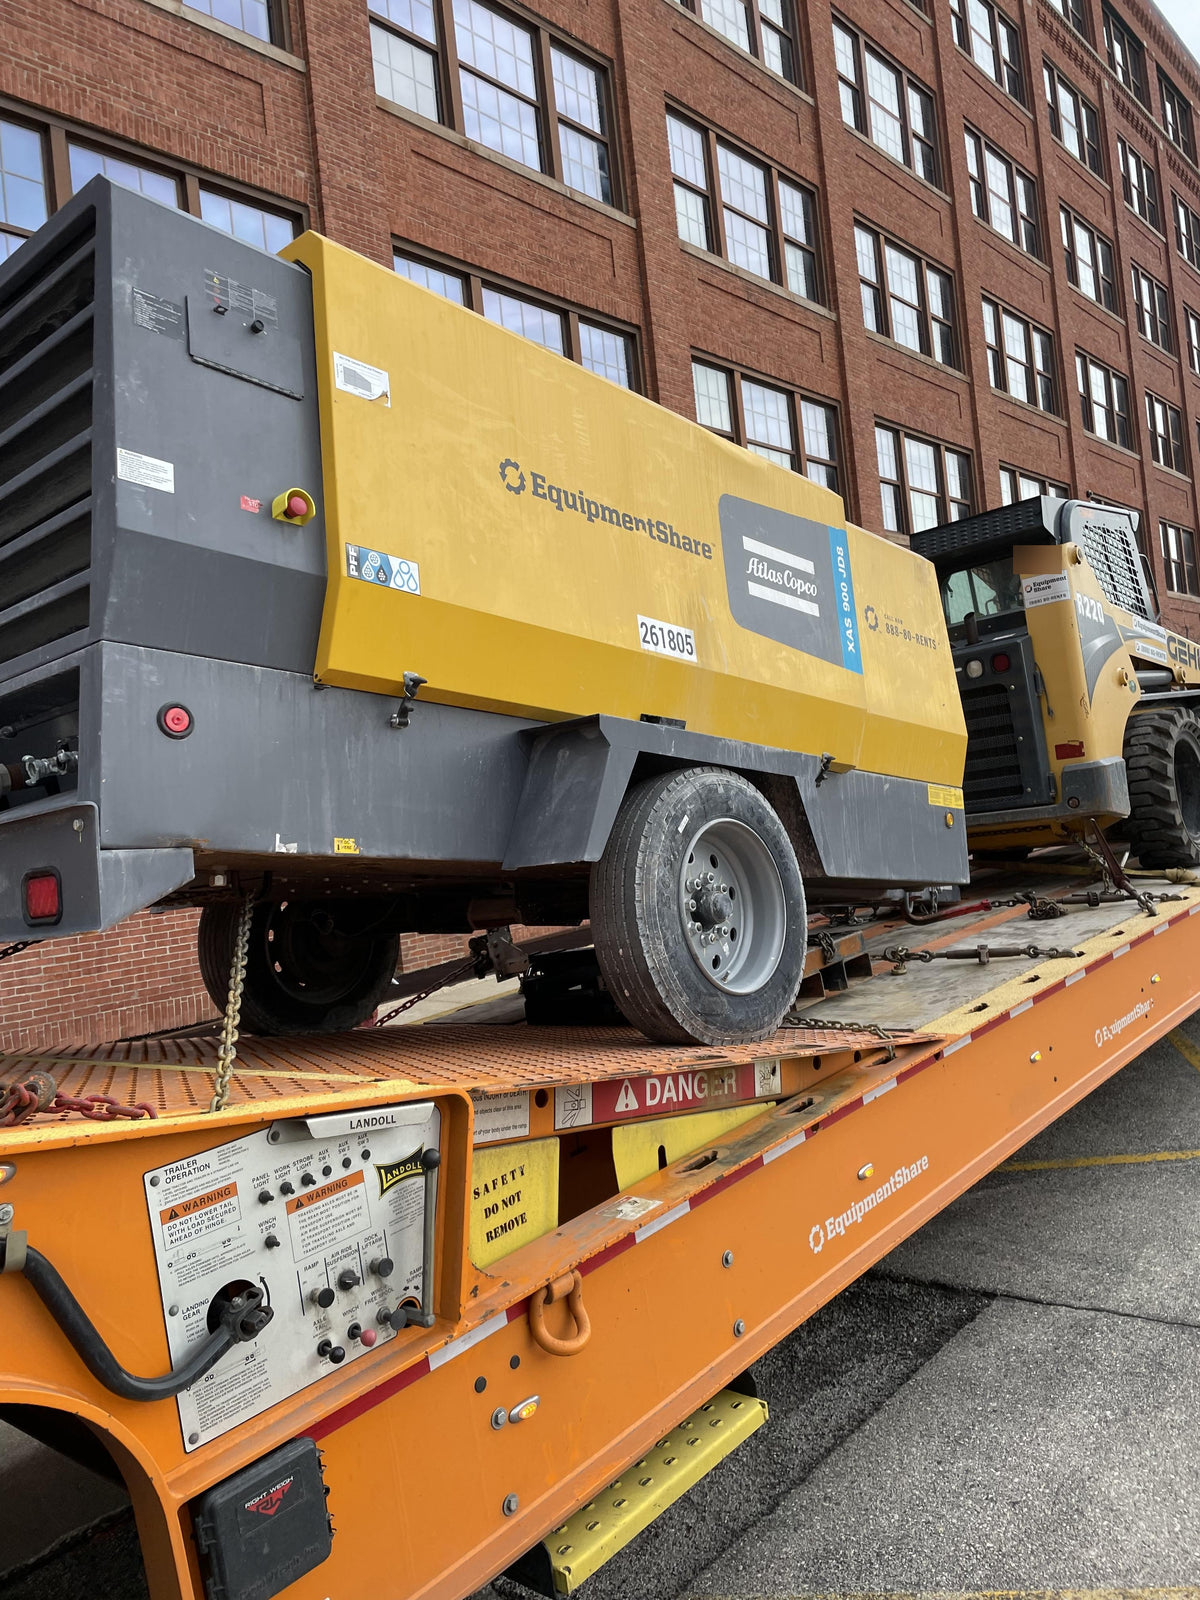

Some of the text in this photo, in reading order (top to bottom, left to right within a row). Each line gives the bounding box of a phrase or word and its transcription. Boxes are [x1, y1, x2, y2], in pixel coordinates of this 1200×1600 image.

[530, 471, 713, 560] EquipmentShare
[348, 545, 359, 576] PFF
[746, 557, 818, 597] Atlas Copco
[1032, 575, 1067, 588] Equipment
[840, 581, 852, 612] 900
[1033, 585, 1052, 593] Share
[1075, 592, 1105, 626] R220
[640, 621, 694, 656] 261805
[844, 617, 856, 654] XAS
[885, 622, 938, 651] 888-80-RENTS
[645, 1067, 737, 1107] DANGER
[349, 1114, 397, 1130] LANDOLL
[338, 1140, 349, 1149] AUX
[357, 1132, 368, 1140] AUX
[357, 1139, 366, 1147] SW
[318, 1148, 329, 1157] AUX
[318, 1155, 327, 1163] SW
[338, 1147, 346, 1155] SW
[164, 1159, 198, 1177] TRAILER
[274, 1163, 291, 1174] WORK
[292, 1154, 314, 1167] STROBE
[296, 1161, 312, 1172] LIGHT
[165, 1162, 211, 1184] OPERATION
[251, 1172, 271, 1183] PANEL
[275, 1170, 292, 1181] LIGHT
[380, 1161, 422, 1190] LANDOLL
[473, 1164, 526, 1200] SAFETY
[253, 1178, 271, 1189] LIGHT
[306, 1179, 349, 1202] WARNING
[182, 1186, 232, 1213] WARNING
[484, 1190, 522, 1220] DO NOT
[824, 1155, 929, 1241] EquipmentShare
[167, 1201, 234, 1232] DO NOT LOWER TAIL
[168, 1206, 238, 1239] WITH LOAD SECURED
[257, 1215, 277, 1229] WINCH
[169, 1231, 193, 1246] AHEAD
[194, 1226, 204, 1235] OF
[485, 1212, 528, 1244] REMOVE
[363, 1233, 378, 1243] DOCK
[326, 1248, 359, 1268] SUSPENSION
[331, 1245, 352, 1259] AIR RIDE
[303, 1260, 319, 1272] RAMP
[181, 1297, 210, 1315] LANDING
[364, 1296, 378, 1306] FREE
[182, 1309, 201, 1321] GEAR
[342, 1304, 359, 1317] WINCH
[244, 1475, 294, 1509] RIGHT WEIGH
